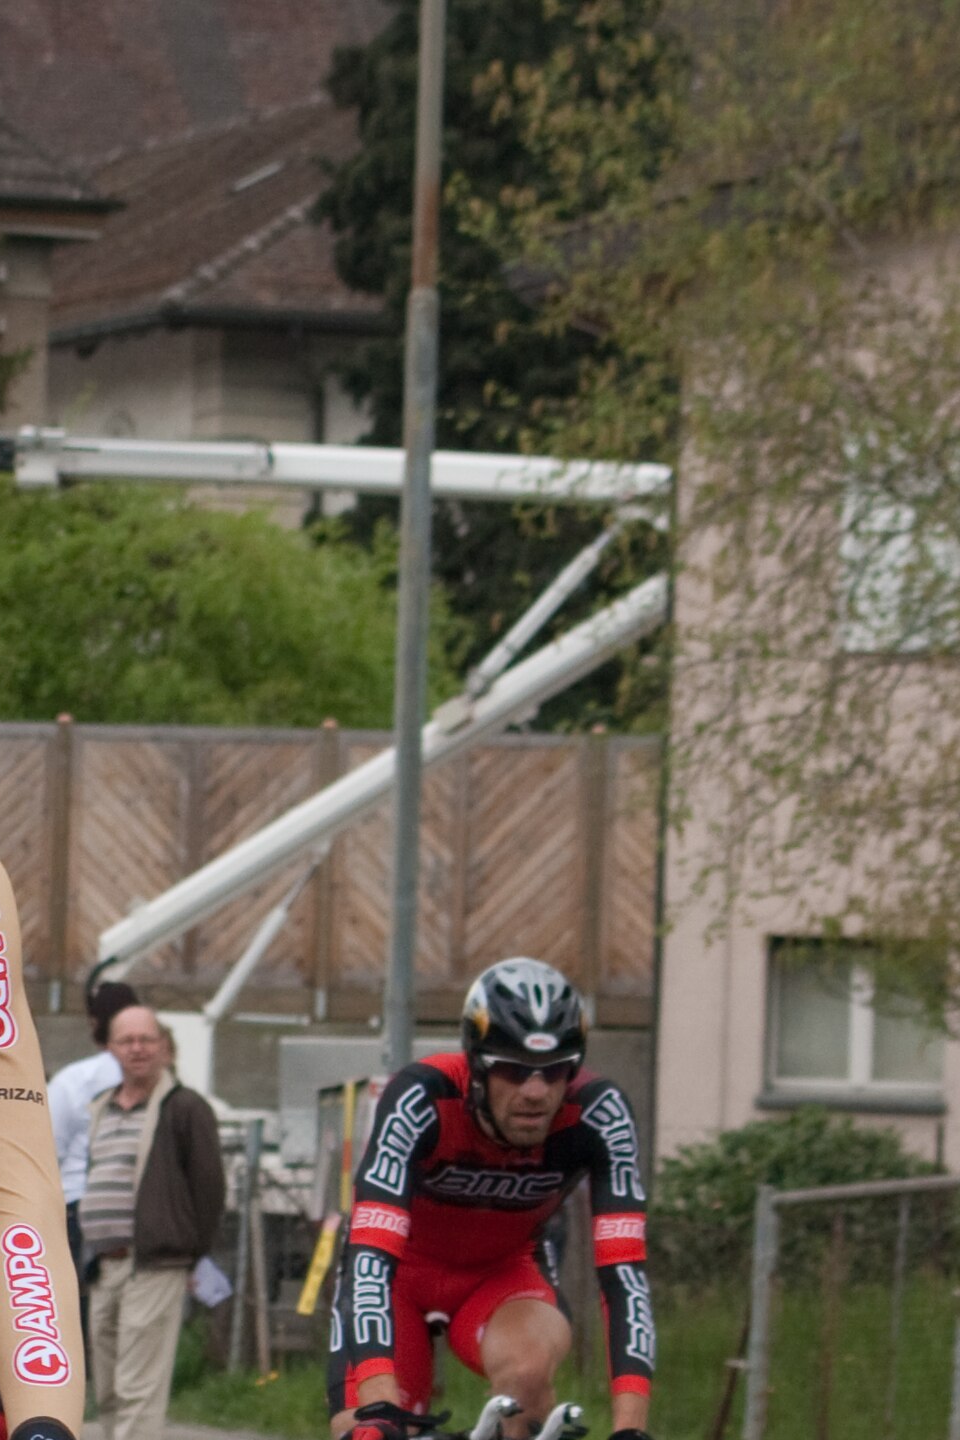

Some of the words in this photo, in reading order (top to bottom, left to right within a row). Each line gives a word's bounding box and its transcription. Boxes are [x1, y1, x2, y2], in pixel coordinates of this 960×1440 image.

[364, 1083, 438, 1196] BMC
[424, 1165, 565, 1201] BMC
[581, 1087, 647, 1201] BMC
[353, 1251, 392, 1347] BMC
